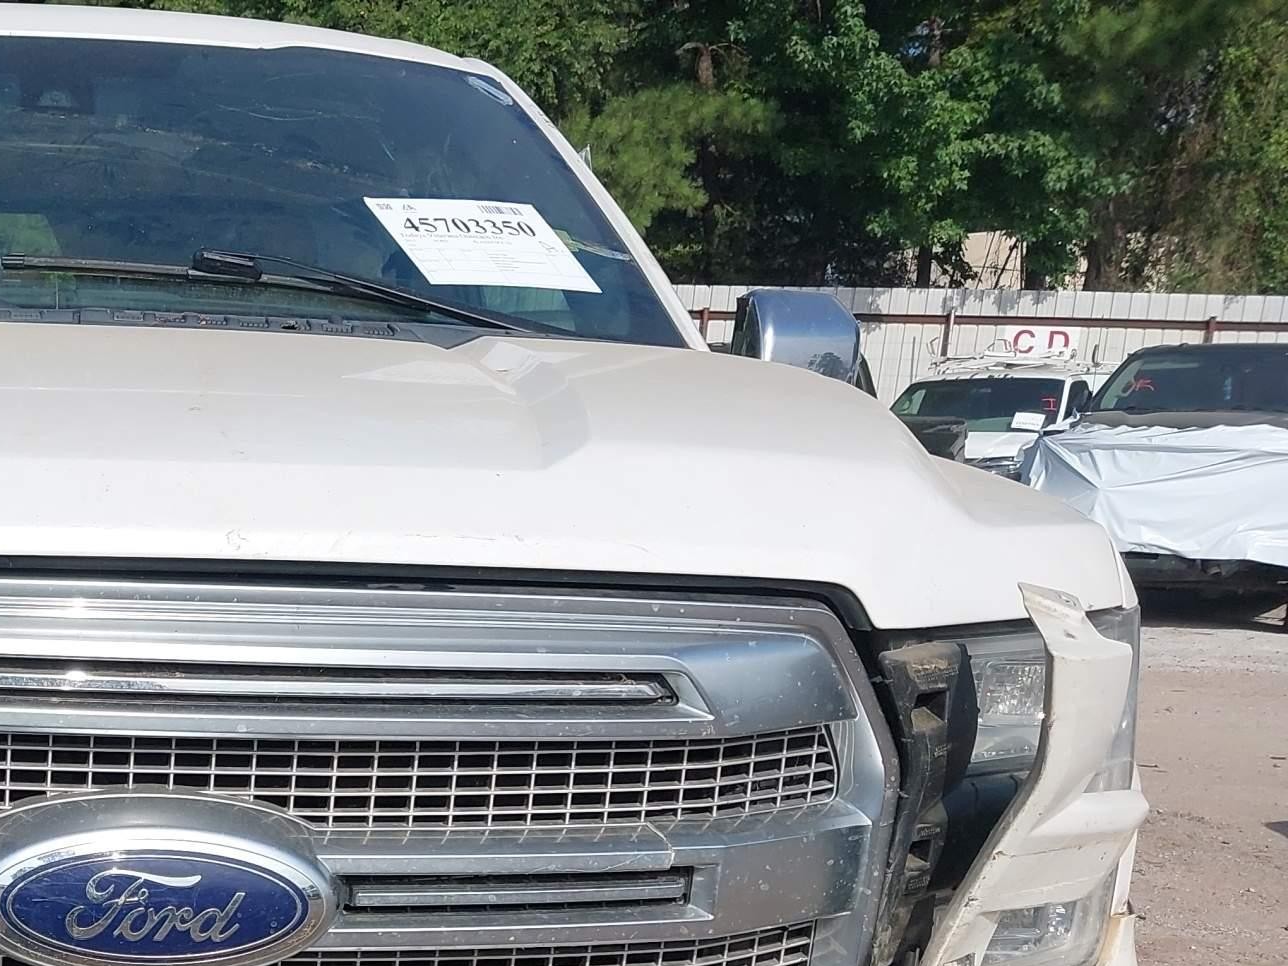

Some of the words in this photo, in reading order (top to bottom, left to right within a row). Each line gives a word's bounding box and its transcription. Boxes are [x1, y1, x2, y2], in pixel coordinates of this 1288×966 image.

[404, 217, 536, 237] 45703350
[1013, 329, 1036, 353] C
[65, 867, 246, 943] Ford
